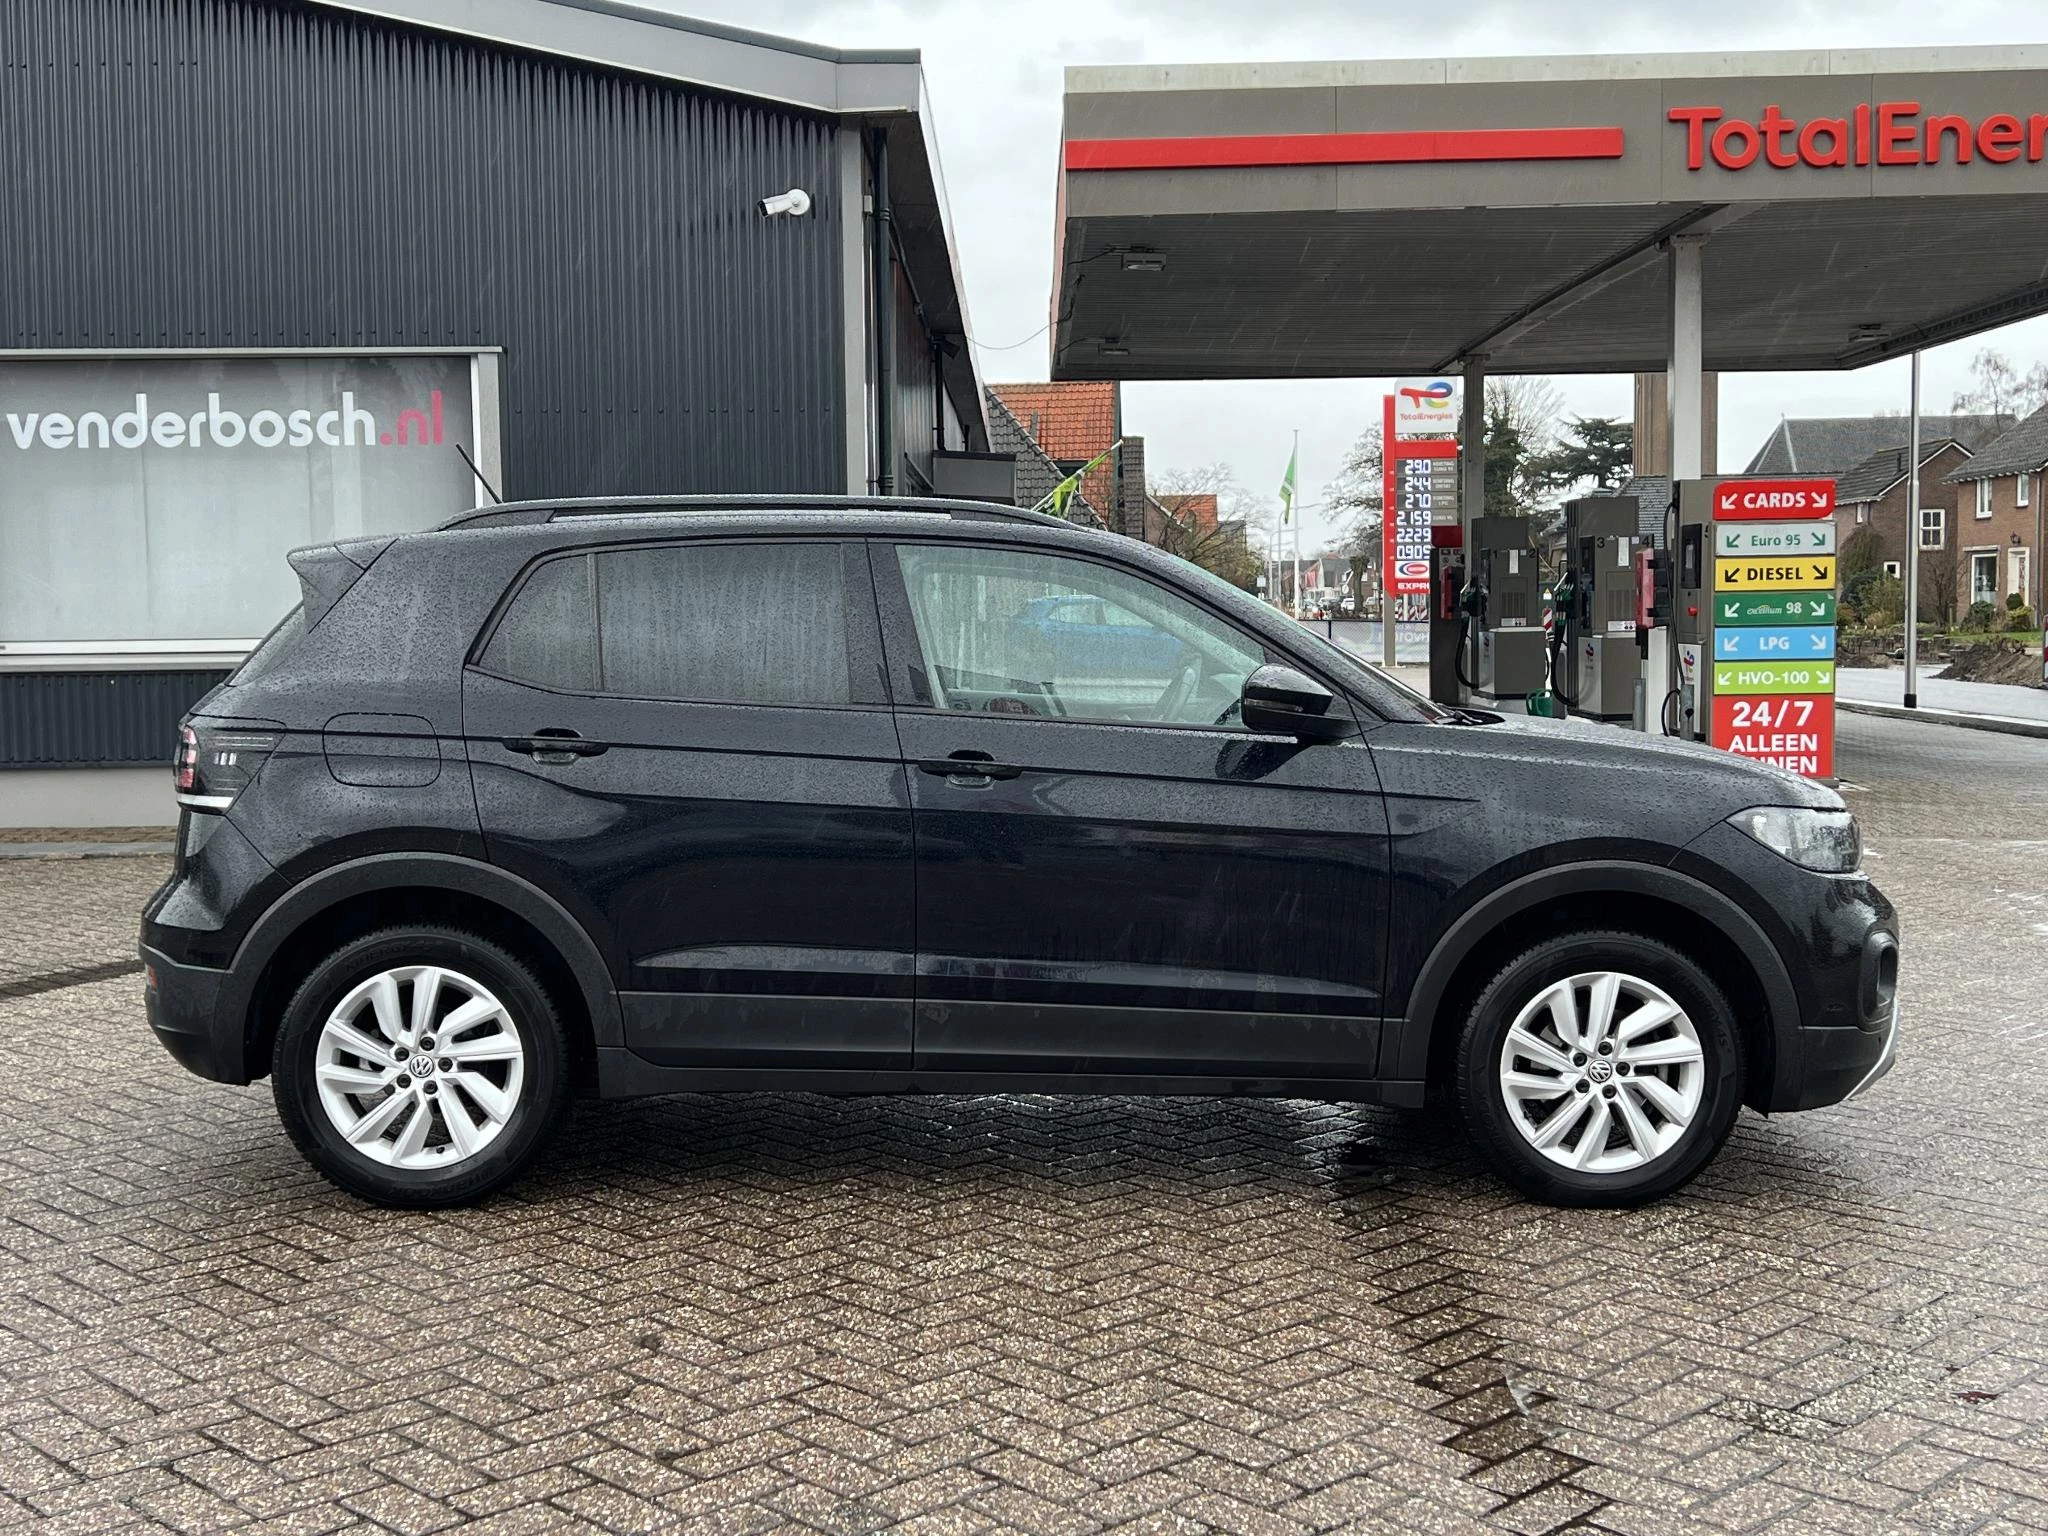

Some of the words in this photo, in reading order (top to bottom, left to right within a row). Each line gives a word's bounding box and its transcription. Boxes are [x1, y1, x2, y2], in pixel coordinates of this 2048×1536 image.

[6, 391, 443, 450] venderbosch.nl
[1743, 492, 1806, 509] CARDS
[1597, 536, 1605, 549] 3
[1642, 535, 1650, 547] 4
[1751, 535, 1781, 547] Euro
[1785, 534, 1801, 546] 95
[1747, 567, 1803, 581] DIESEL
[1786, 602, 1802, 614] 98
[1759, 637, 1789, 650] LPG
[1738, 670, 1810, 685] HVO-100
[1732, 700, 1814, 728] 24/7
[1728, 734, 1817, 753] ALLEEN
